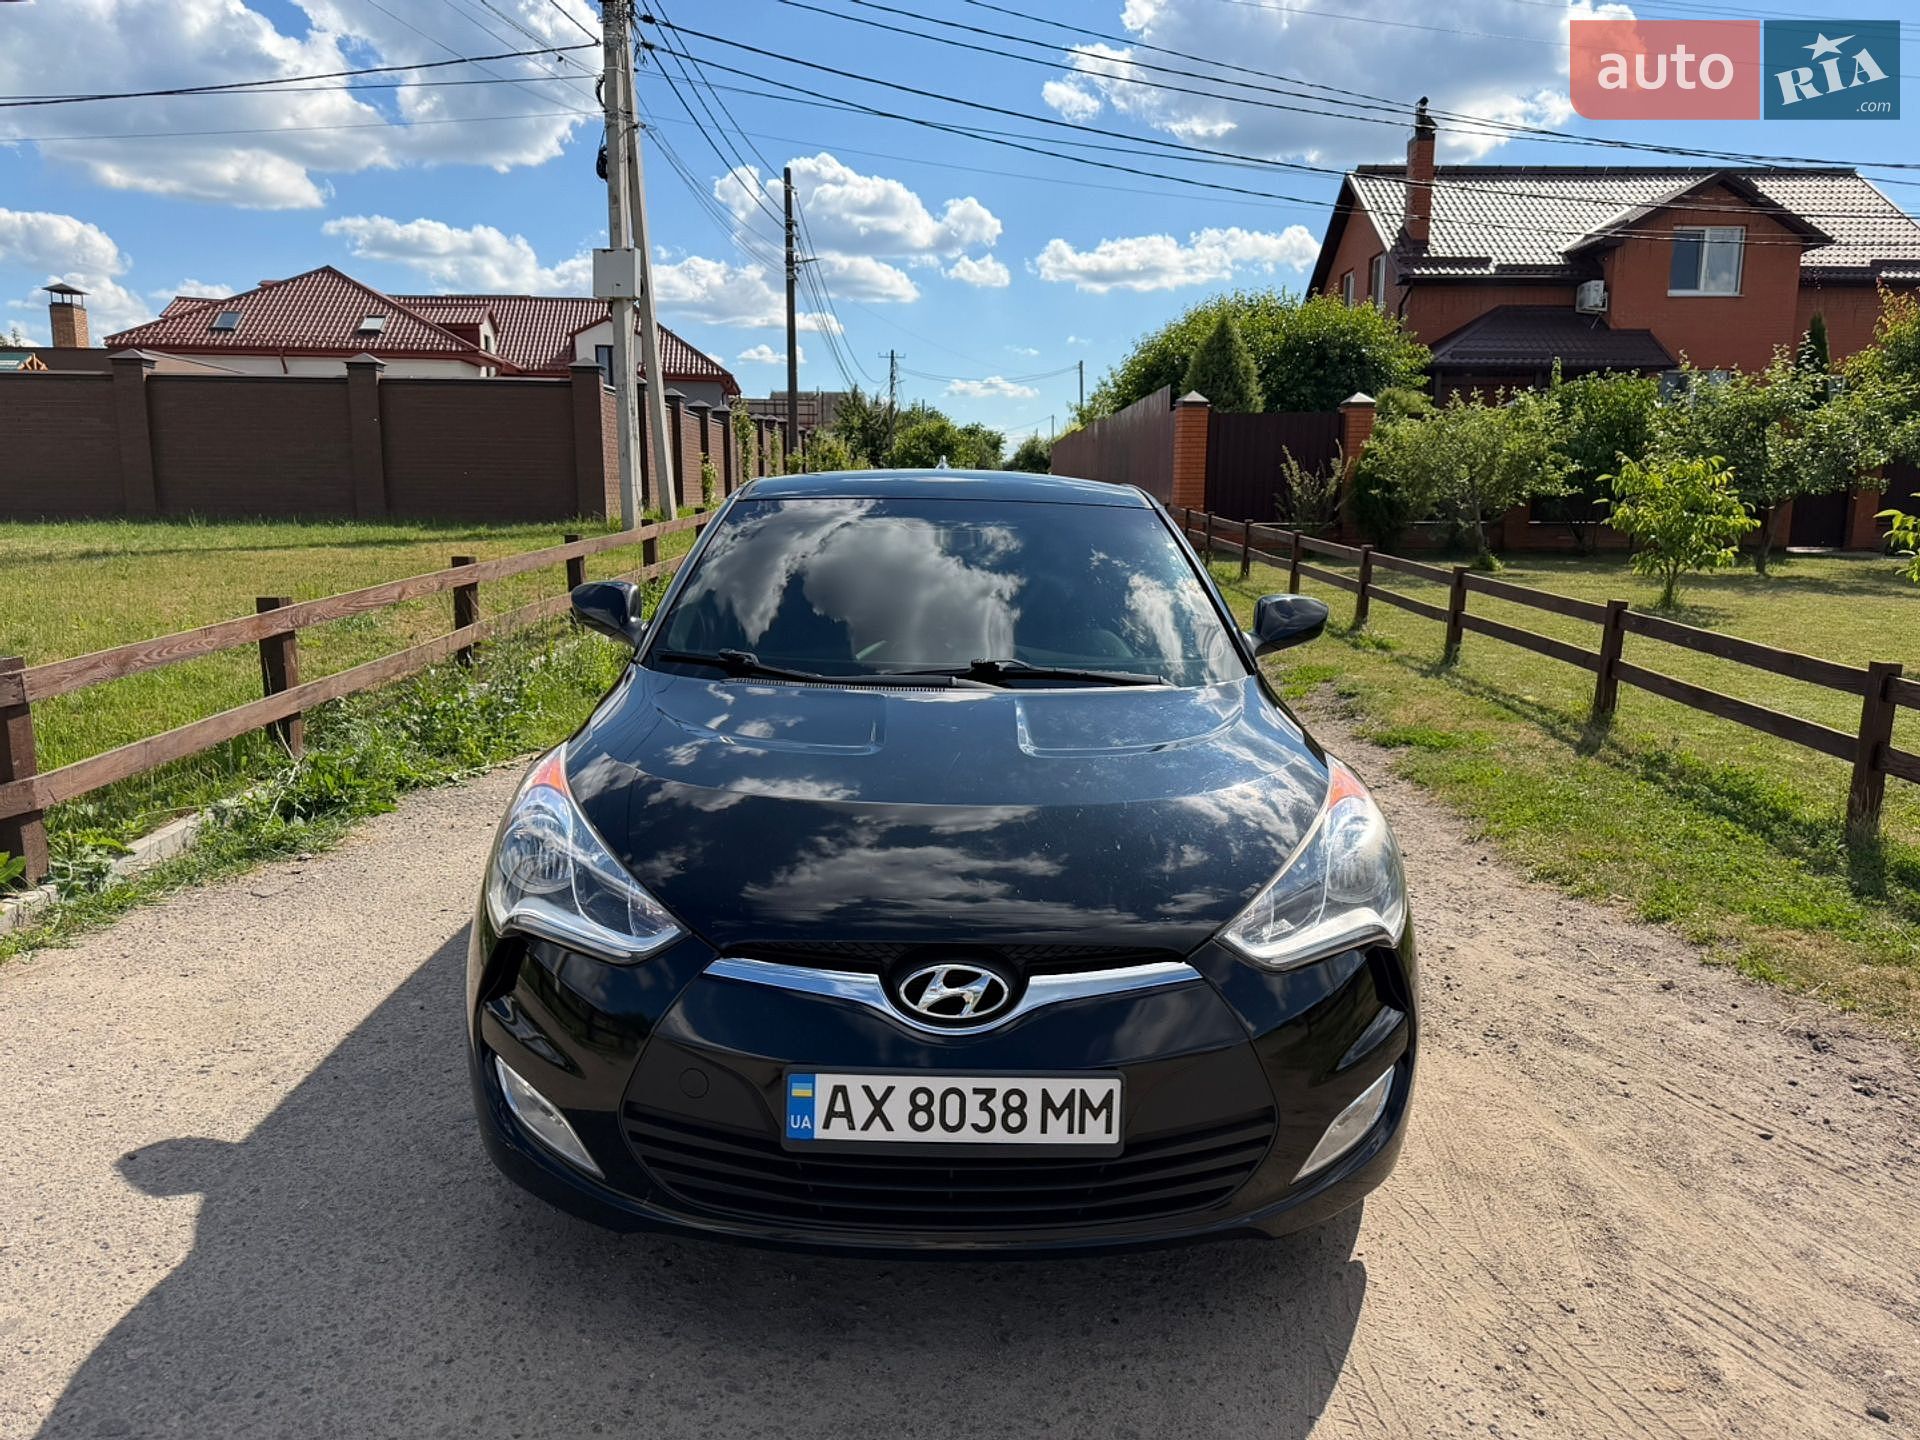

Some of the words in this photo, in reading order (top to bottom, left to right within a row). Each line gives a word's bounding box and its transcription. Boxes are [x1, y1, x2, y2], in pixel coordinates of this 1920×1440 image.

[790, 1115, 812, 1130] UA
[822, 1085, 896, 1132] AX
[908, 1087, 1028, 1134] 8038
[1040, 1088, 1114, 1135] MM
